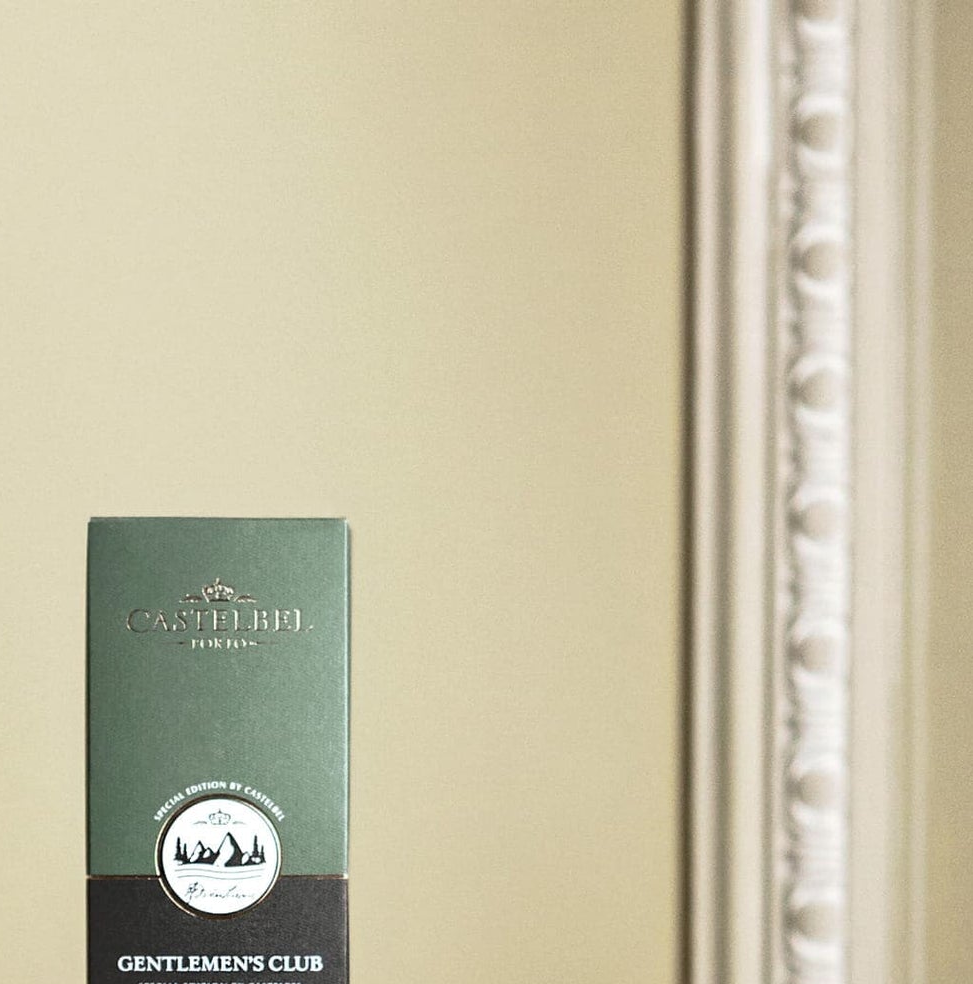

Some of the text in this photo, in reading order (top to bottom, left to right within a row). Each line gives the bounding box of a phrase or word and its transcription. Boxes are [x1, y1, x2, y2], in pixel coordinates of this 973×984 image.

[126, 609, 314, 633] CASTELBEL
[154, 781, 286, 822] SPECIAL EDITION BY CASTELBEL
[117, 955, 323, 972] GENTLEMEN'S CLUB
